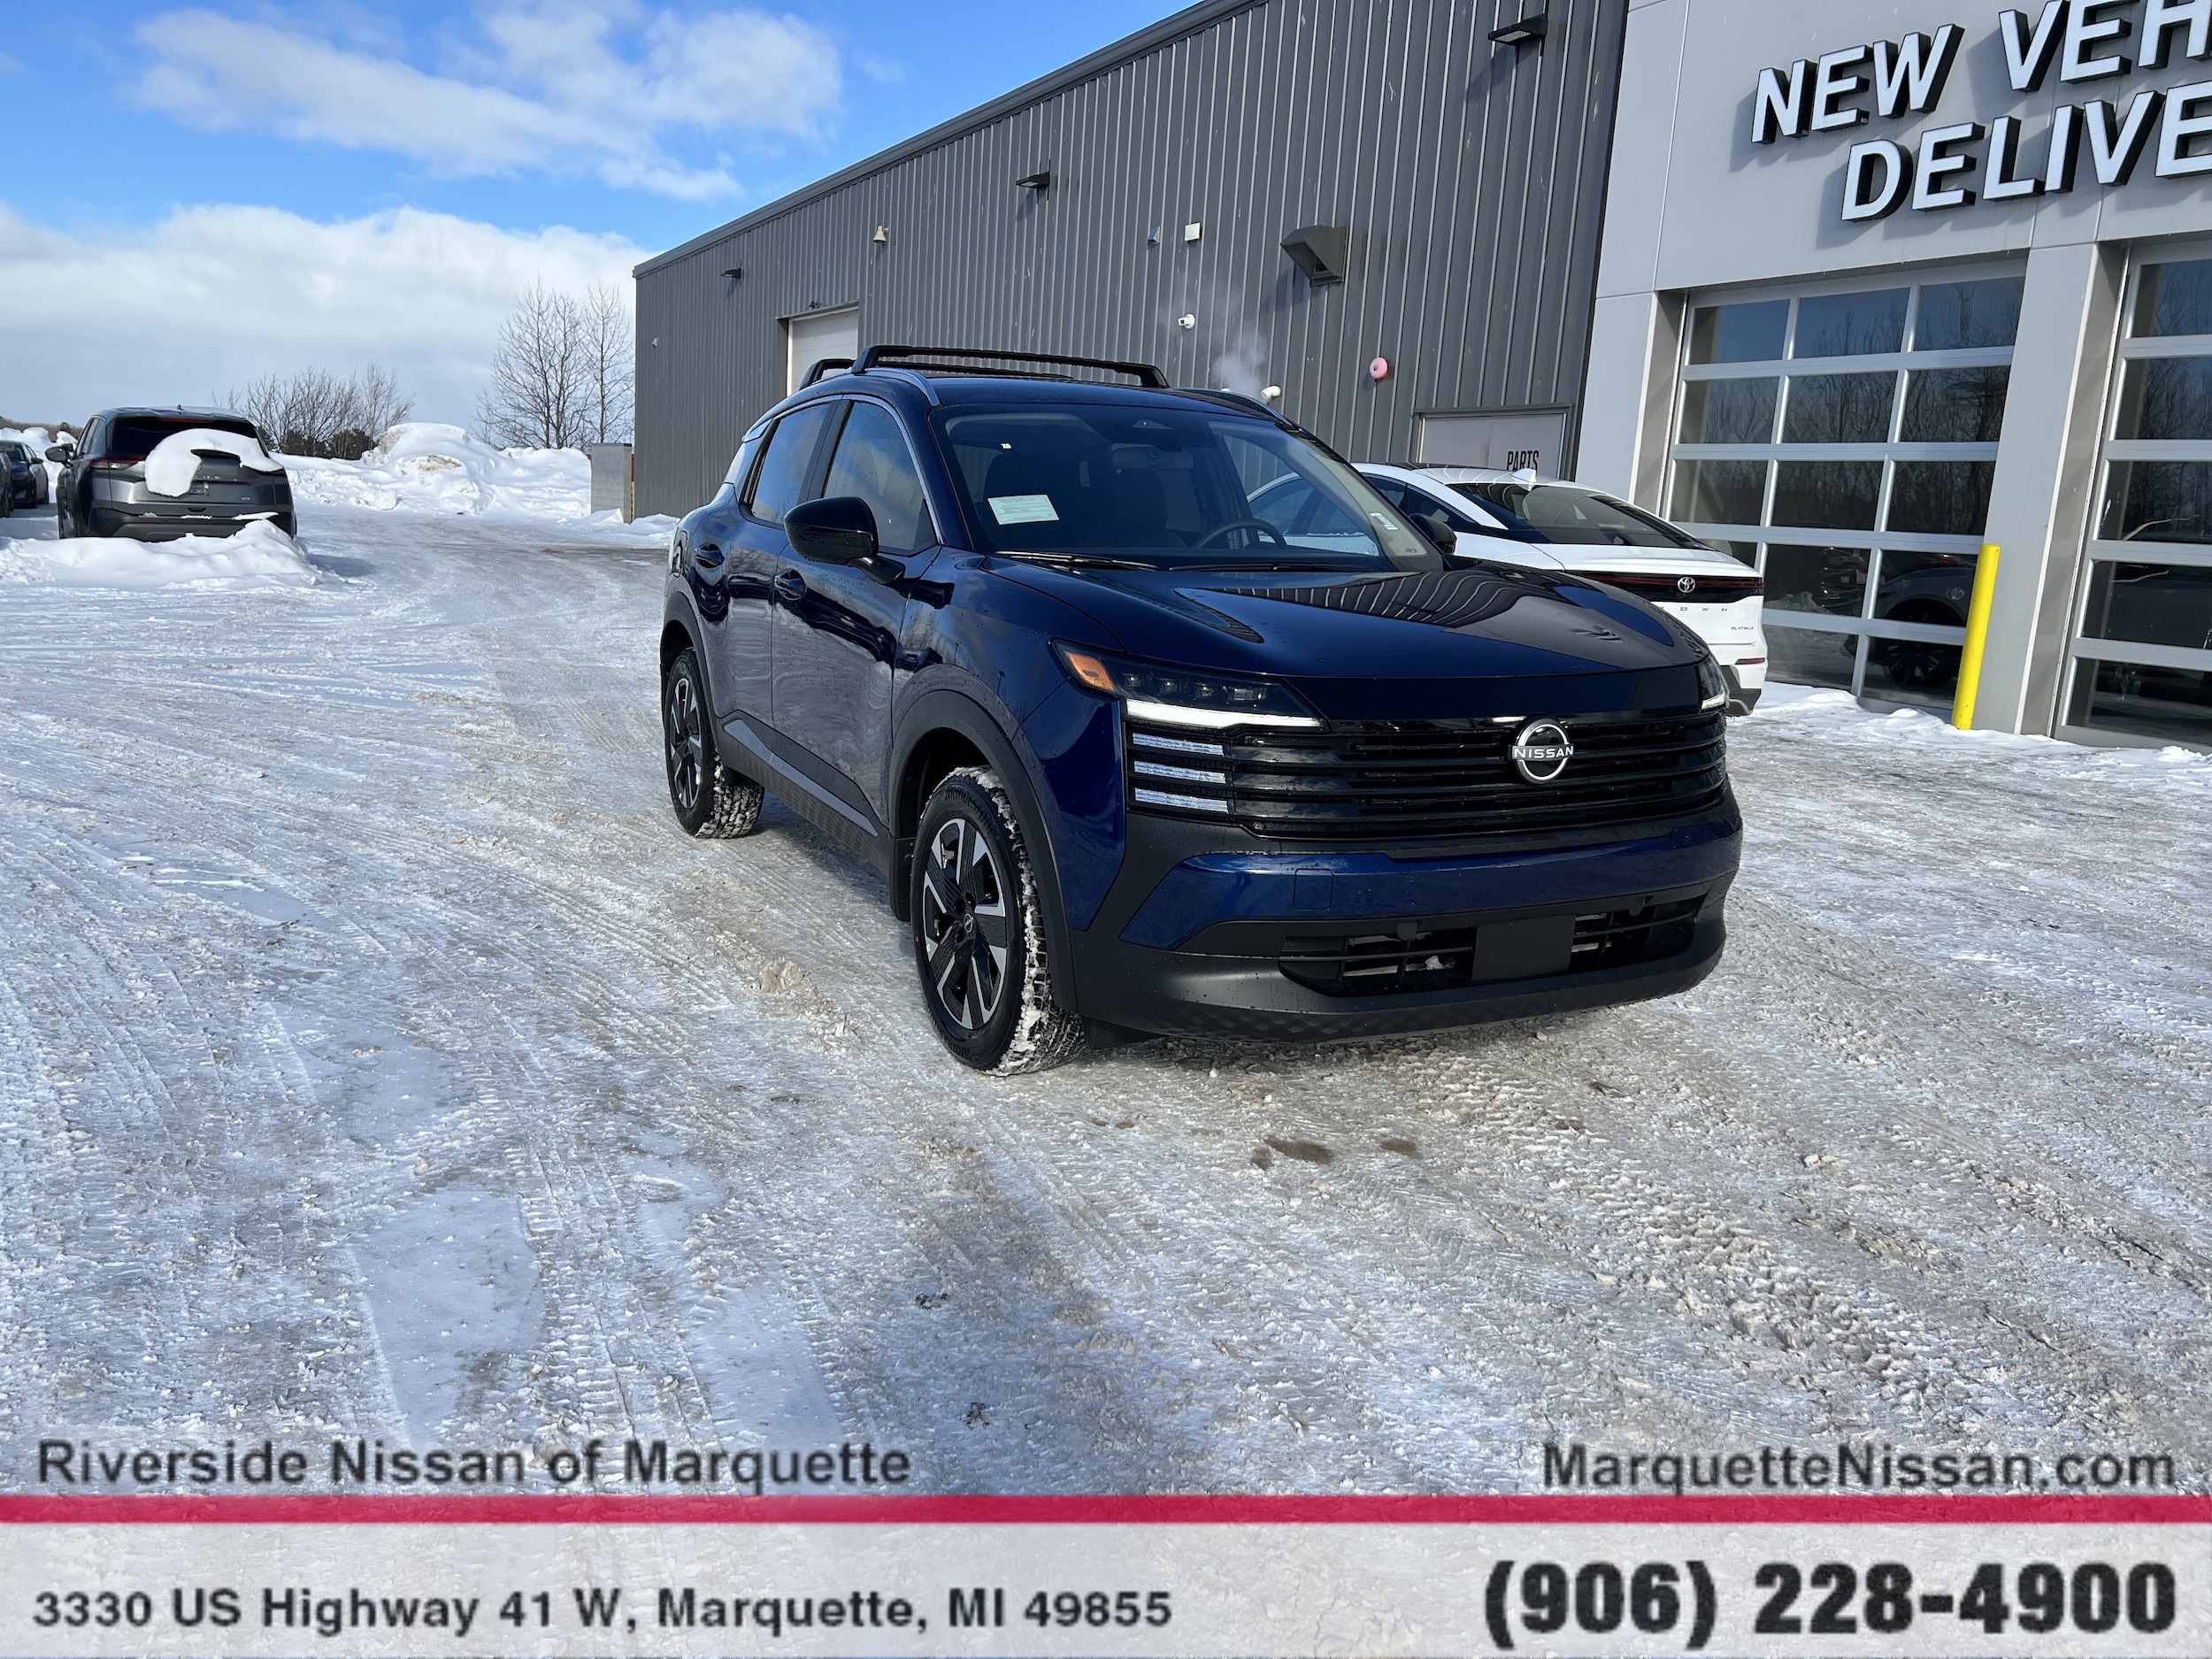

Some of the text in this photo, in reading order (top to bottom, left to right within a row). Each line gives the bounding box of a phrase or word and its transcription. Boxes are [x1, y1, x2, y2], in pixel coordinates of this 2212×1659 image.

[1751, 23, 1964, 144] NEW
[1506, 449, 1540, 474] PARTS
[1514, 745, 1574, 759] NISSAN
